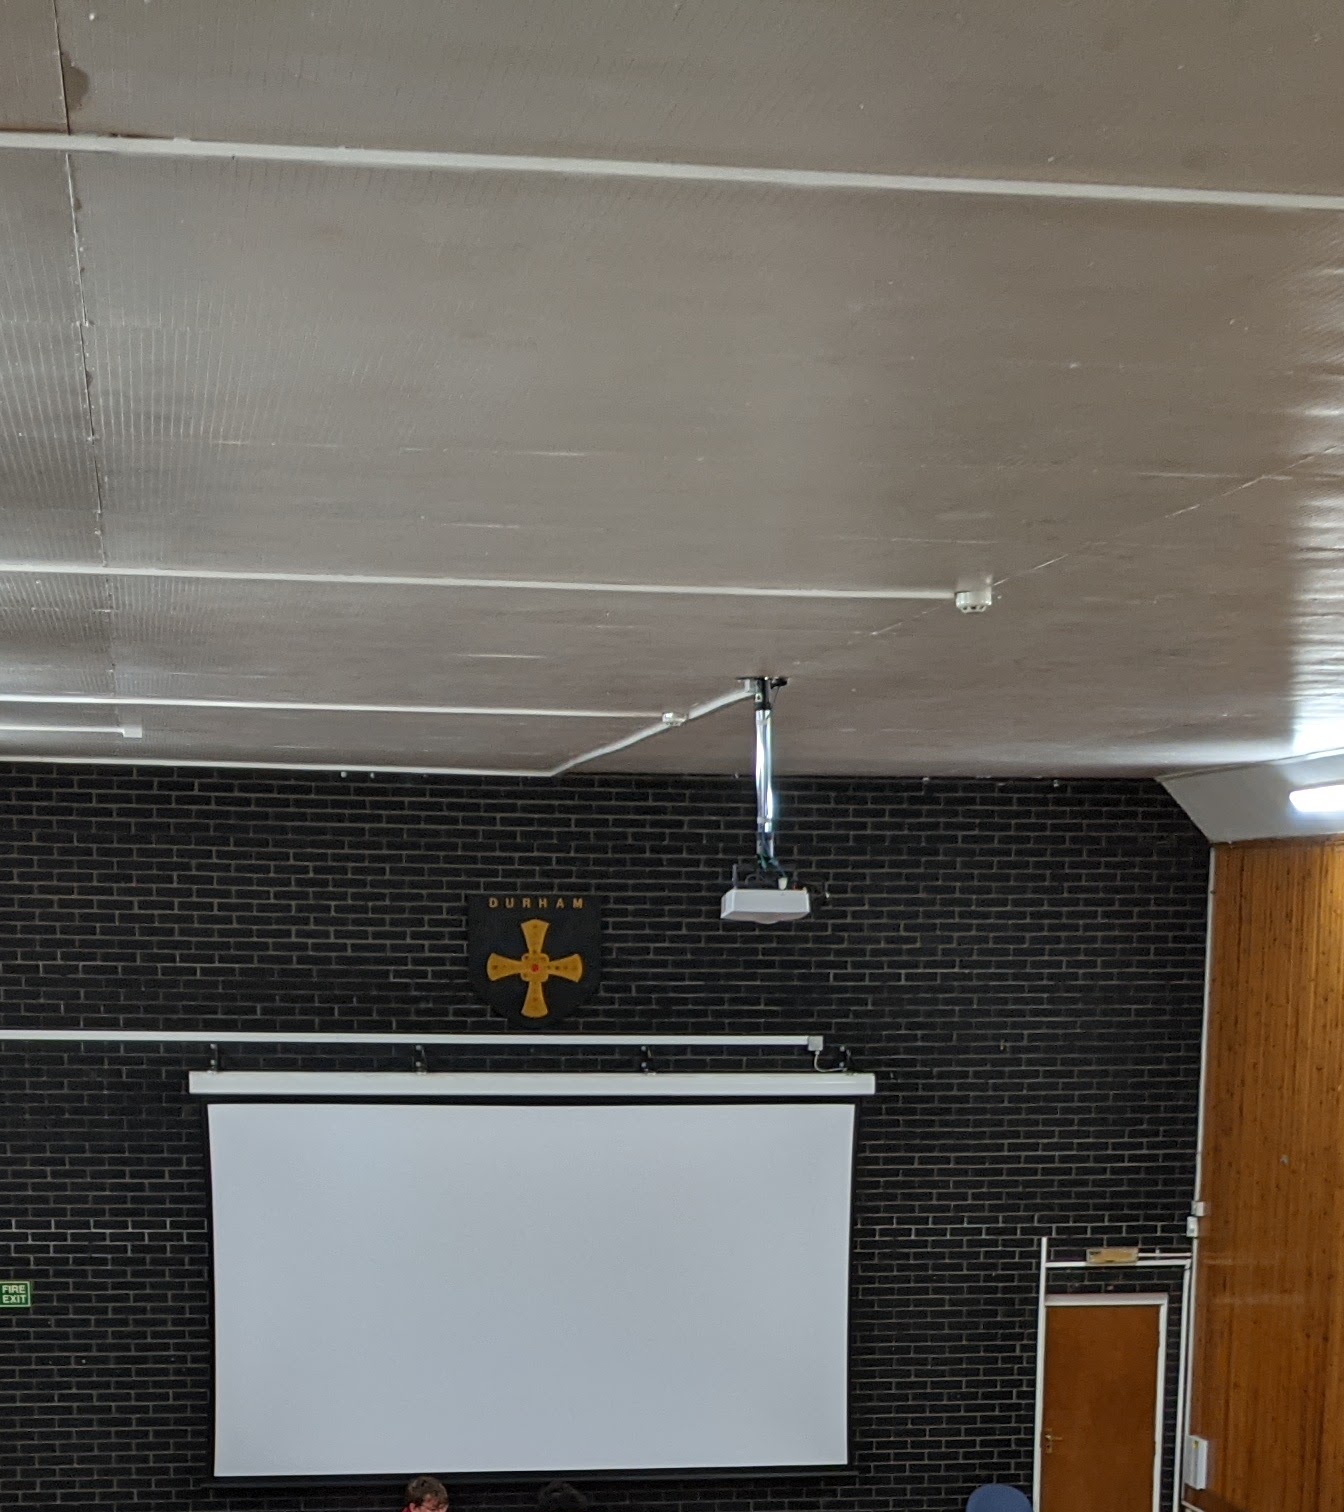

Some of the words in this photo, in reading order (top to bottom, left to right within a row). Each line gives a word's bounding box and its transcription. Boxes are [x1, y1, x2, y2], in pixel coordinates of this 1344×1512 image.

[488, 897, 584, 909] DURHAM
[1, 1284, 26, 1294] FIRE
[2, 1294, 27, 1304] EXIT
